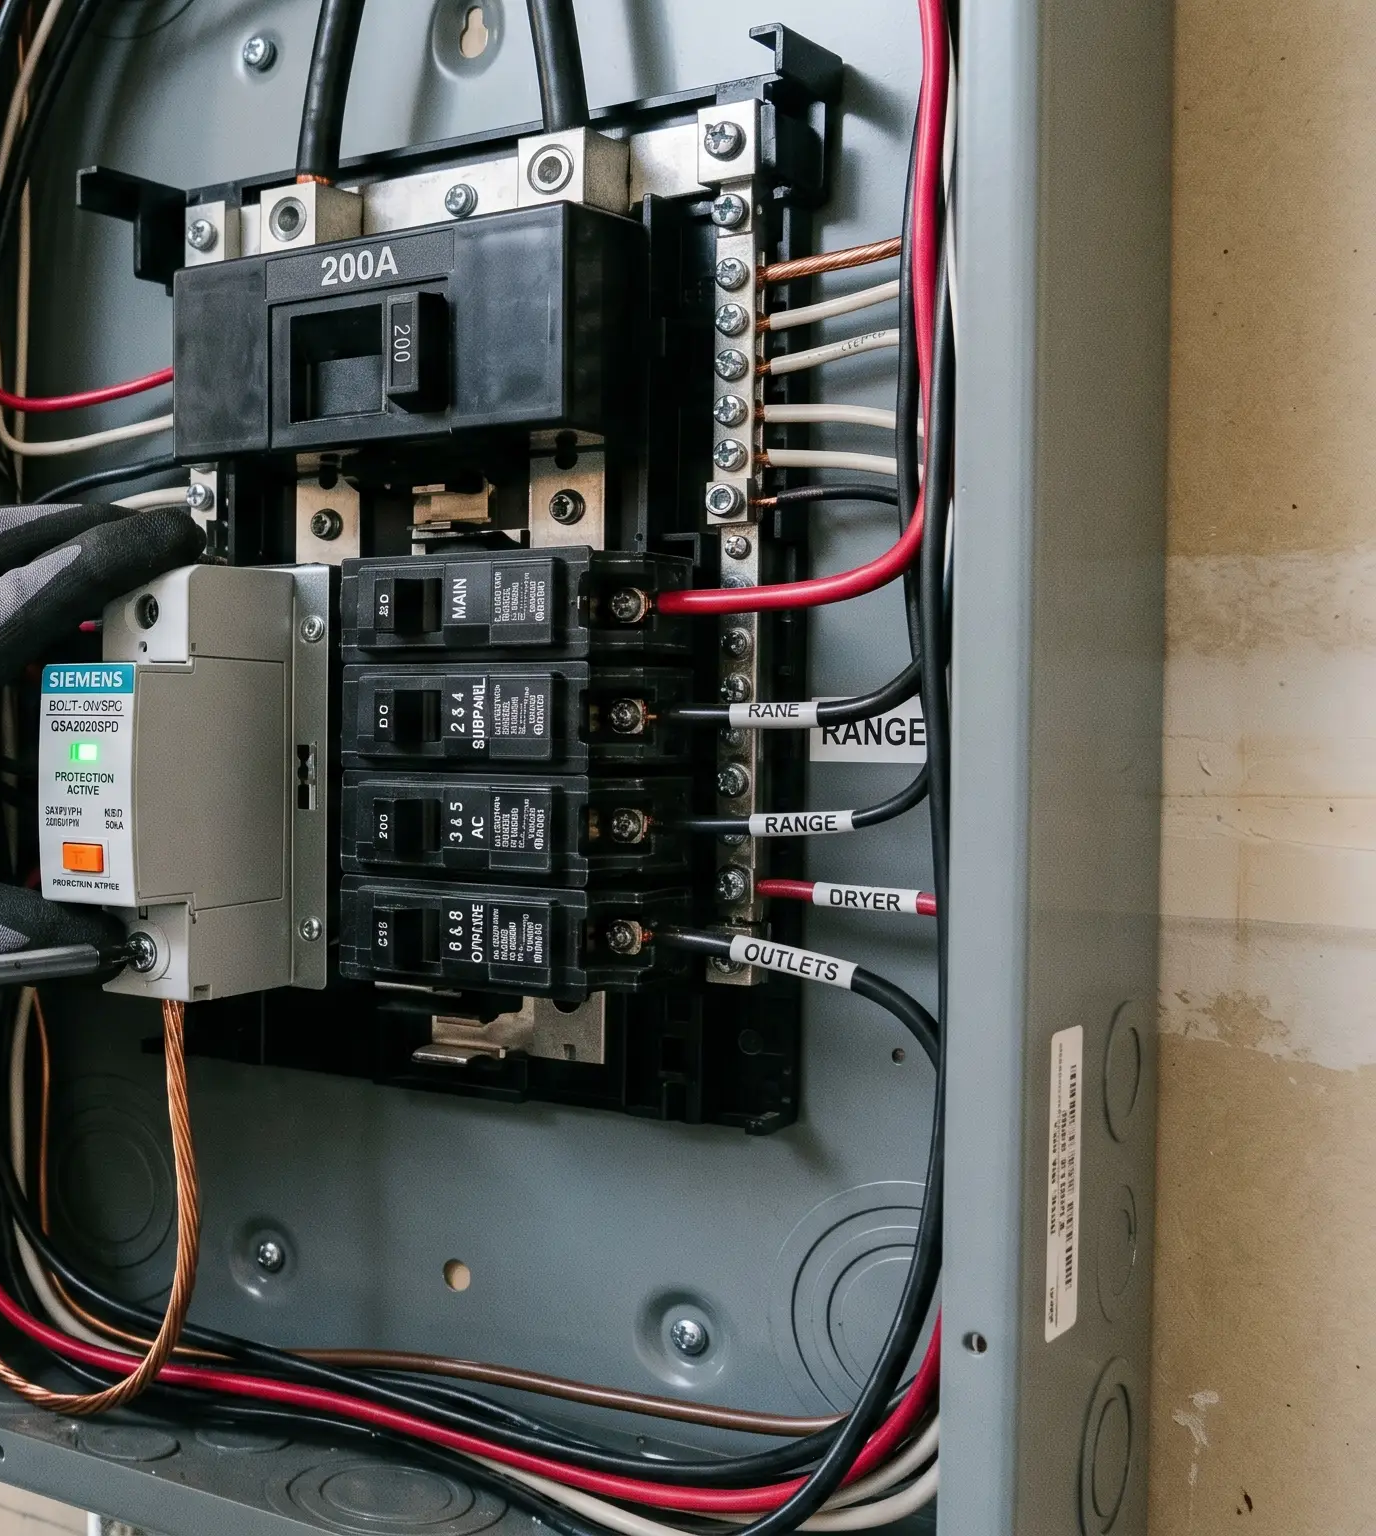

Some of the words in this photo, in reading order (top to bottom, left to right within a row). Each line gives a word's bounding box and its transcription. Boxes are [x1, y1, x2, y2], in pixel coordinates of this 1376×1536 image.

[321, 246, 399, 286] 200A
[394, 324, 411, 362] 200
[451, 578, 467, 619] MAIN
[49, 671, 124, 688] SIEMENS
[748, 703, 800, 718] RANE
[51, 720, 119, 732] QSA2020SPD
[822, 718, 927, 746] RANGE
[55, 771, 115, 783] PROTECTION
[67, 785, 100, 796] ACTIVE
[450, 802, 463, 812] 5
[471, 816, 484, 839] AC
[765, 815, 838, 833] RANGE
[449, 832, 463, 843] 3
[829, 889, 901, 912] DRYER
[744, 943, 840, 981] OUTLETS
